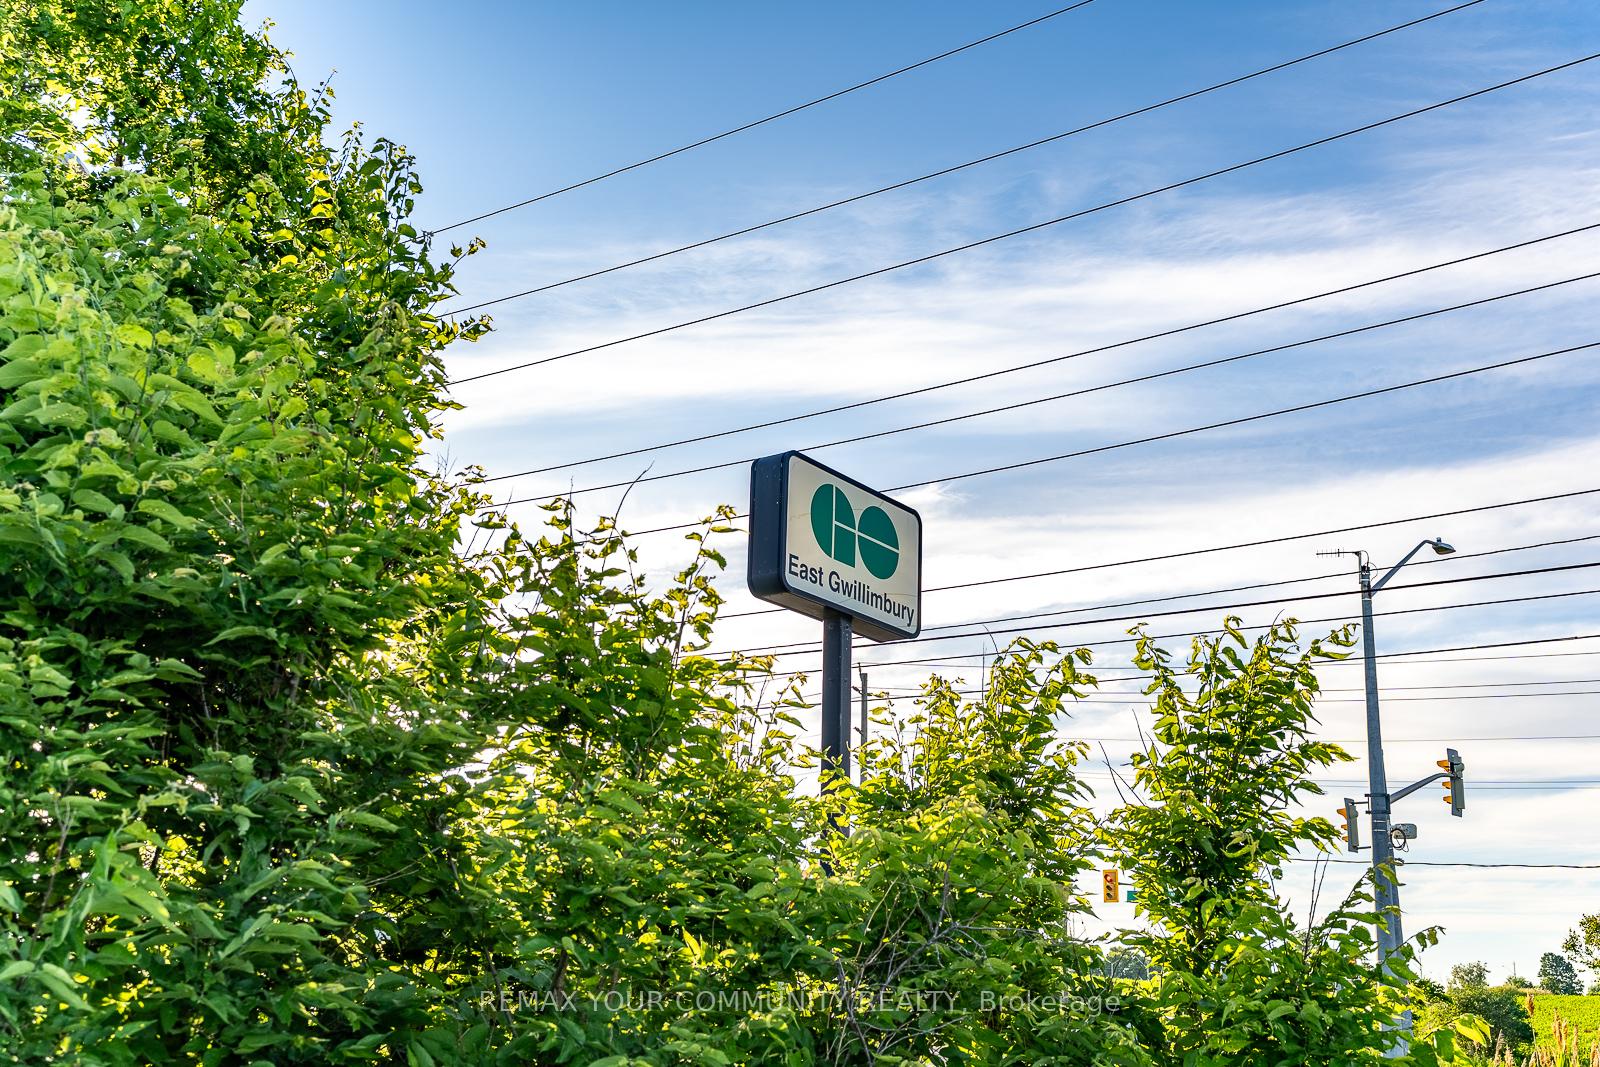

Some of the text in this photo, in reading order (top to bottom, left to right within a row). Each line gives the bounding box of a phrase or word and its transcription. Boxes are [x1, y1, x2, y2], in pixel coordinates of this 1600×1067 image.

[811, 483, 900, 580] GO
[788, 553, 914, 627] East Gwillimbury
